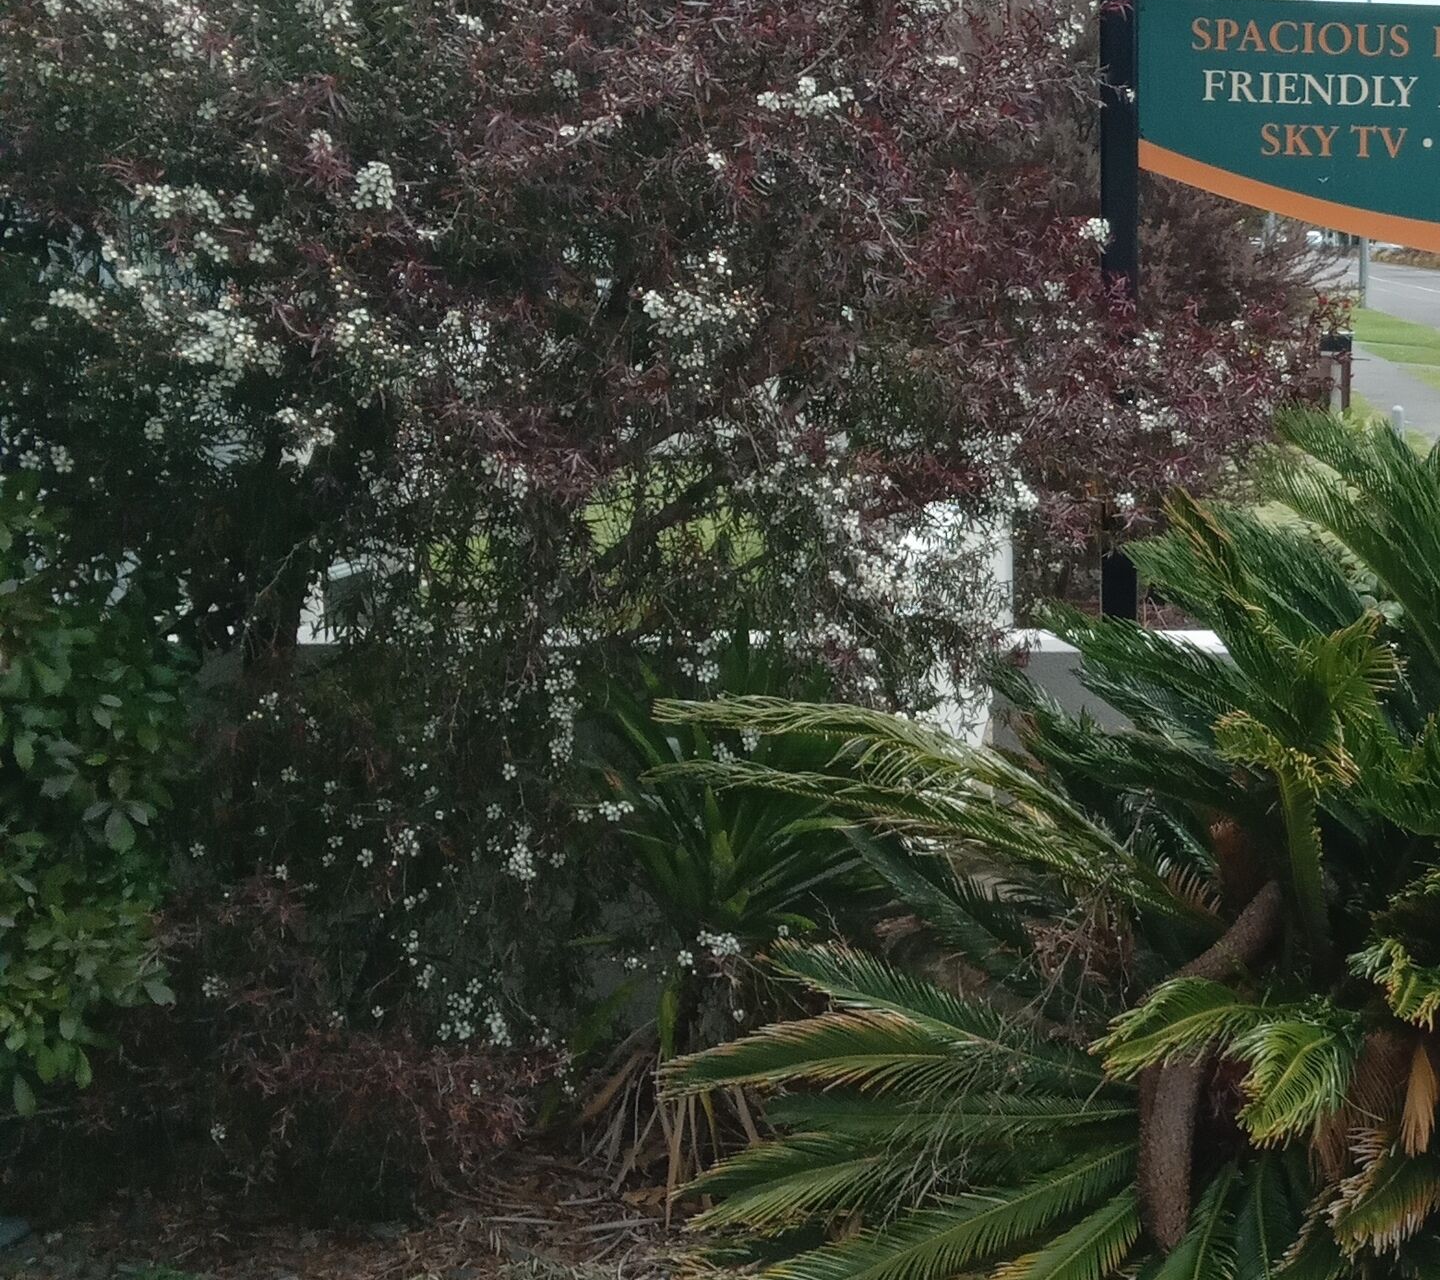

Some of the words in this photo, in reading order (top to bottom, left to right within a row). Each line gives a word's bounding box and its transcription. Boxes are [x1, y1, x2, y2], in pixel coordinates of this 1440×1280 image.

[1191, 17, 1410, 57] SPACIOUS
[1203, 70, 1419, 108] FRIENDLY
[1261, 124, 1340, 157] SKY
[1350, 127, 1408, 159] TV
